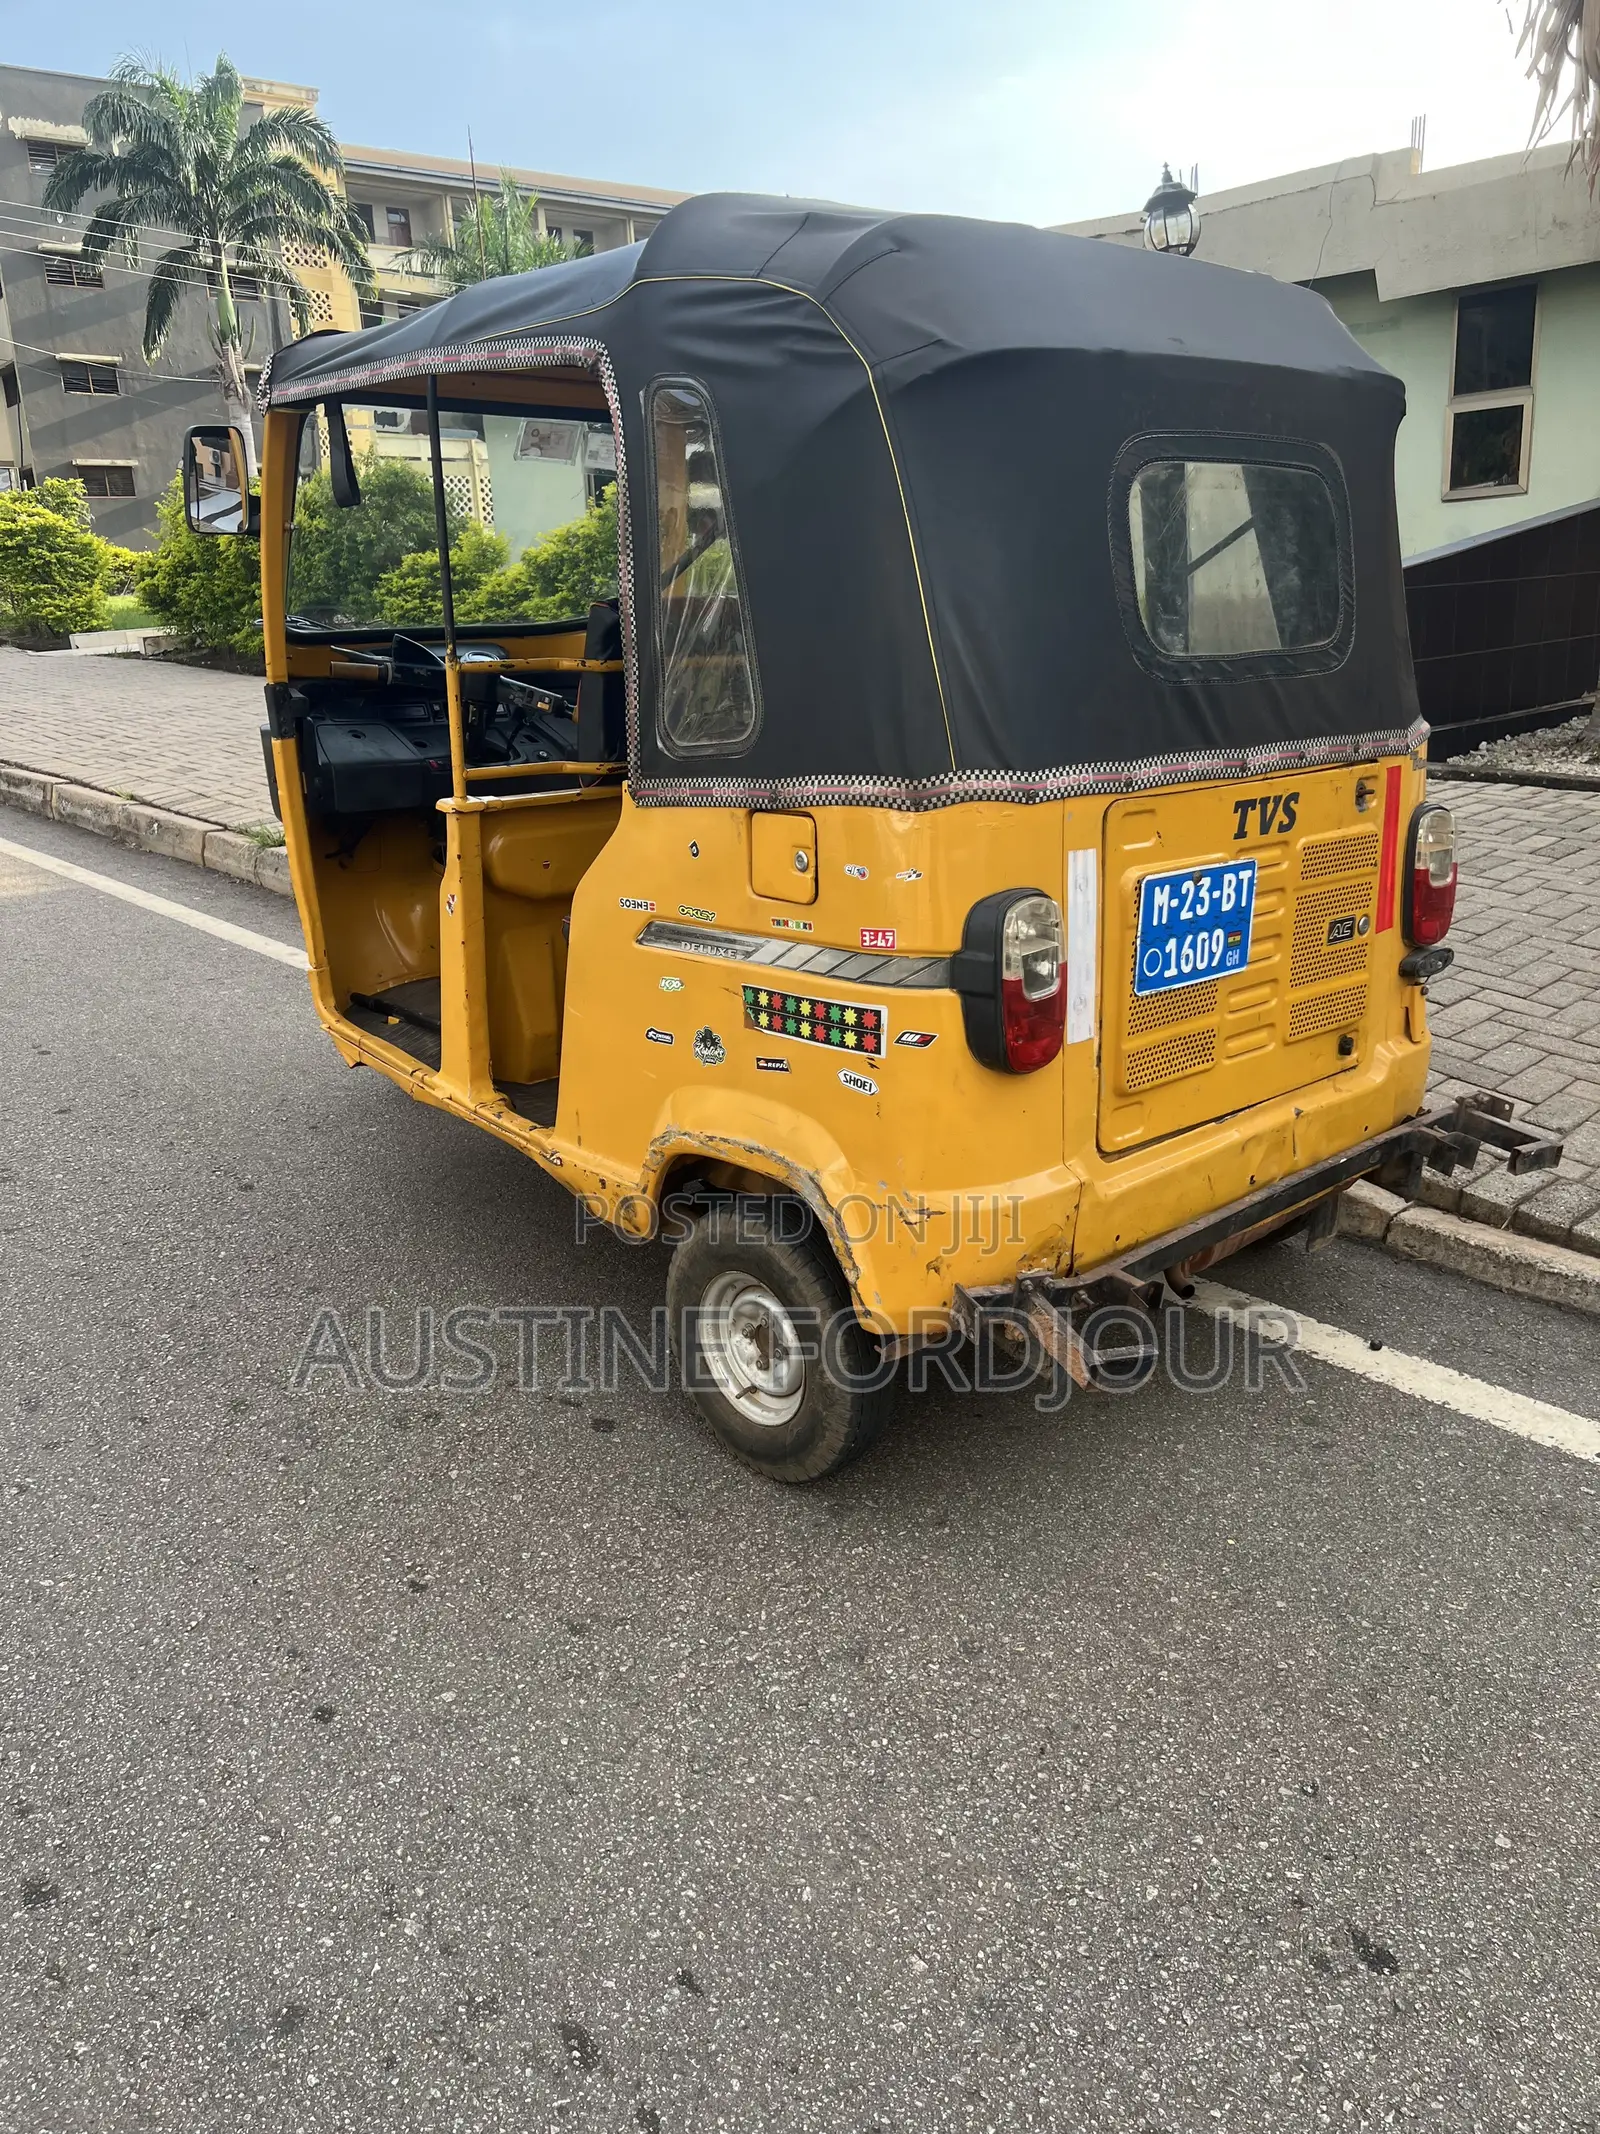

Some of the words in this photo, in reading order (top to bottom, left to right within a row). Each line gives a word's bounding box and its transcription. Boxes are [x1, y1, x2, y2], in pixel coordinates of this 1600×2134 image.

[460, 351, 488, 363] GOCCI
[505, 347, 535, 359] GOCCI
[554, 344, 584, 357] GOCCI
[657, 787, 690, 798] GOCCI
[712, 787, 749, 798] GOCCI
[850, 784, 906, 800] GOCCI
[949, 778, 1011, 792] GOCCI
[1046, 772, 1093, 790] GOCCI
[1188, 758, 1224, 771] GOCCI
[1246, 752, 1279, 768] GOCCI
[1232, 791, 1300, 840] TVS
[619, 898, 649, 911] ENEOS
[1152, 869, 1253, 927] M-23-BT
[678, 905, 716, 921] OAKLEY
[680, 941, 737, 960] DELUXE
[1163, 928, 1225, 978] 1609
[1225, 949, 1241, 967] GH
[842, 1072, 873, 1093] SHOEI
